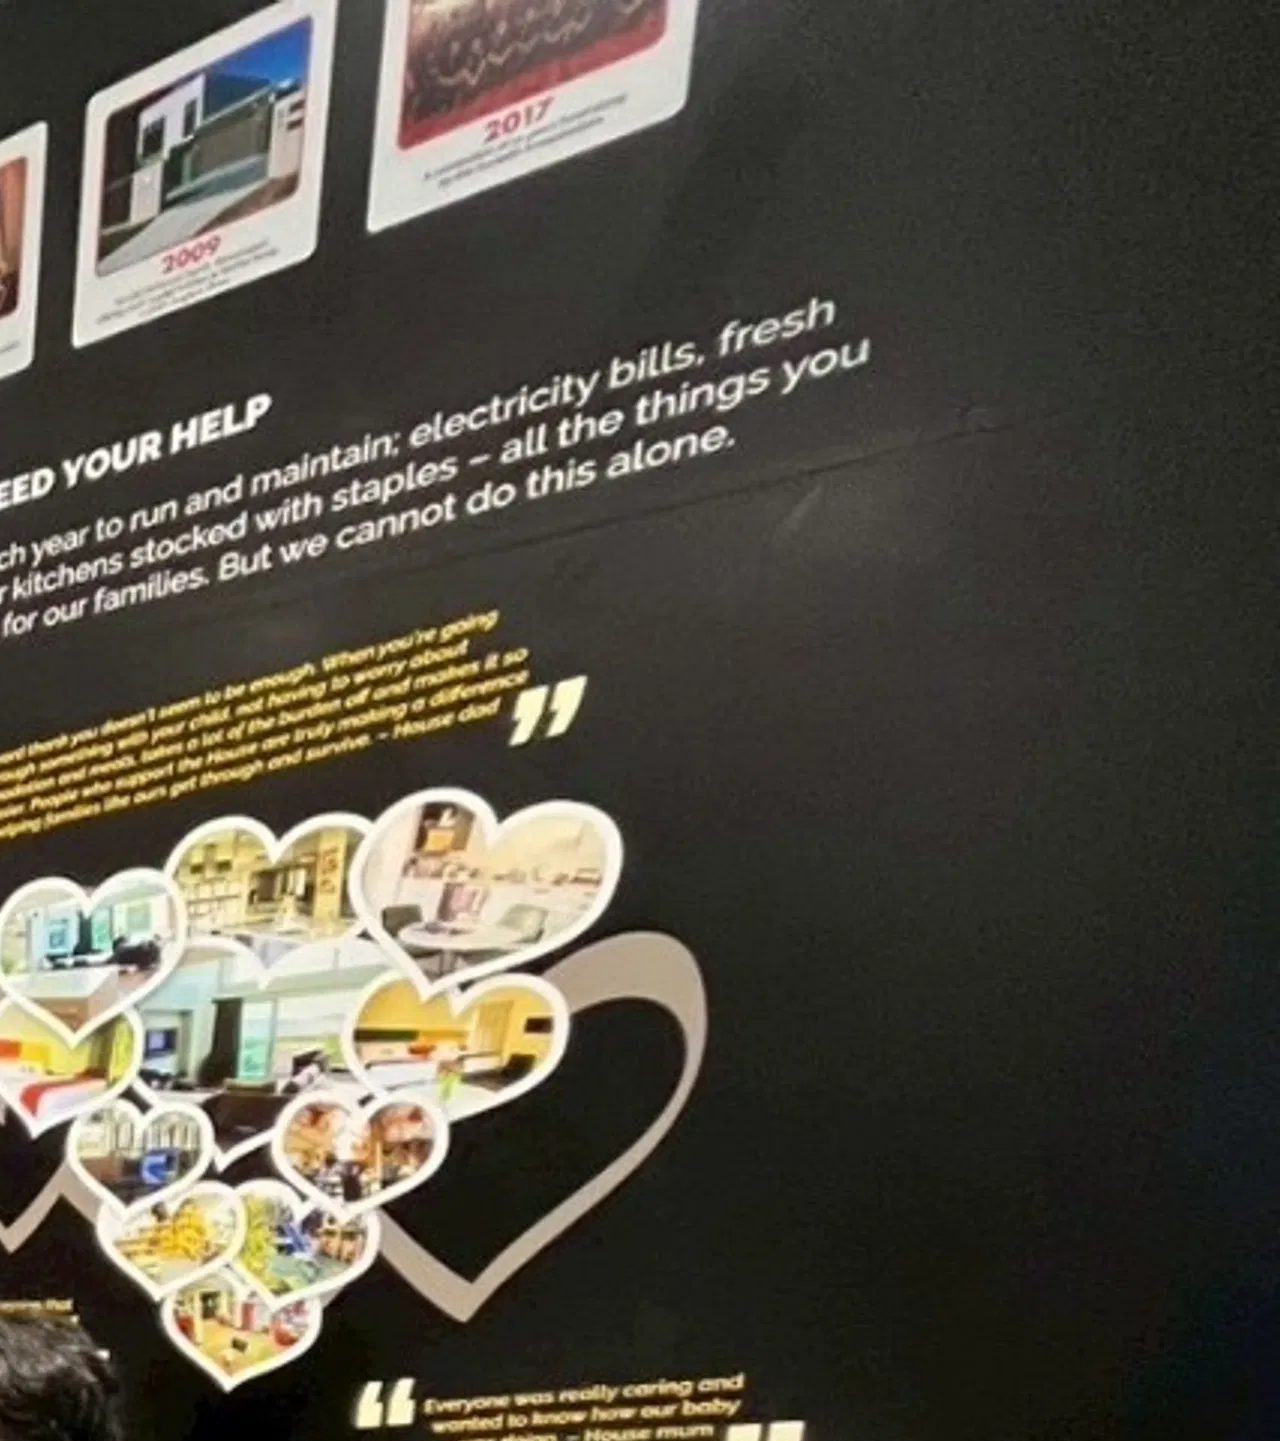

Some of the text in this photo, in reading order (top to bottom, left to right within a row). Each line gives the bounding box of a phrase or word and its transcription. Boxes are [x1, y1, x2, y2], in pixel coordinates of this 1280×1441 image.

[482, 96, 554, 143] 2017
[160, 236, 222, 275] 2009
[31, 527, 89, 563] year
[96, 517, 124, 542] to
[130, 500, 178, 532] run
[184, 474, 243, 515] and
[409, 372, 599, 448] electricity
[720, 298, 834, 356] fresh
[63, 431, 161, 487] YOUR
[170, 394, 271, 454] HELP
[12, 553, 123, 600] kitchens
[130, 511, 247, 568] stocked
[256, 493, 322, 531] with
[332, 457, 457, 511] staples
[500, 424, 548, 463] all
[558, 411, 624, 448] the
[636, 368, 770, 425] things
[782, 338, 869, 395] you
[3, 611, 38, 636] for
[43, 598, 88, 626] our
[94, 567, 209, 613] families.
[218, 544, 272, 580] But
[280, 534, 328, 563] we
[336, 494, 456, 549] cannot
[466, 482, 516, 514] do
[527, 460, 596, 499] this
[606, 426, 735, 478] alone.
[424, 1374, 744, 1414] Everyone was really caring and
[432, 1398, 741, 1432] wanted to know how our baby
[584, 1429, 652, 1441] House
[656, 1425, 714, 1439] mum
